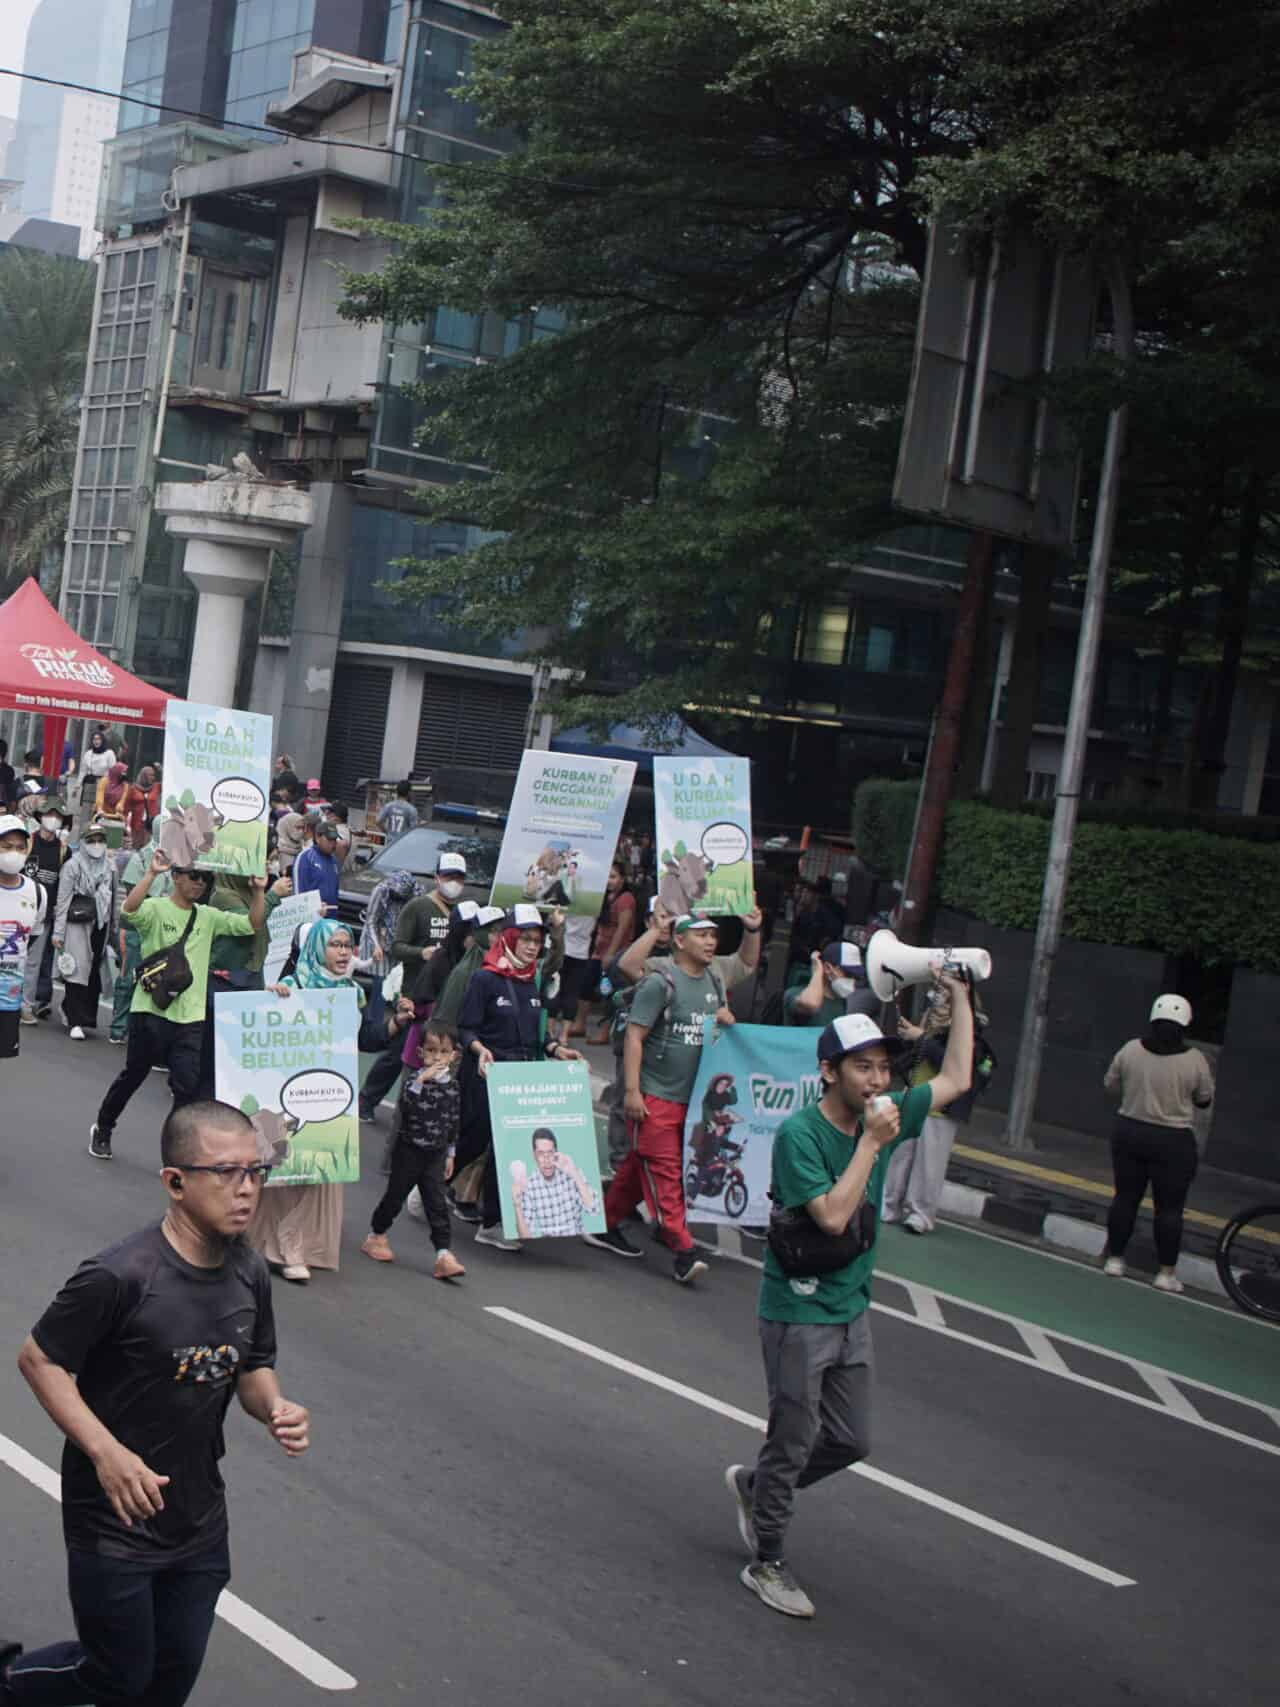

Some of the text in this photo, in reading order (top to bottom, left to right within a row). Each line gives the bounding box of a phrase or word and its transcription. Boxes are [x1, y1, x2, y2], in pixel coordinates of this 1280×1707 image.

[96, 702, 104, 712] di
[185, 736, 254, 760] KURBAN
[184, 753, 241, 772] BELUM
[542, 767, 614, 785] KURBAN DI
[532, 780, 617, 800] GENGGAMAN
[673, 789, 737, 804] KURBAN
[391, 815, 405, 832] 17
[241, 1029, 333, 1049] KURBAN
[240, 1050, 314, 1070] BELUM
[751, 1078, 795, 1111] Fun
